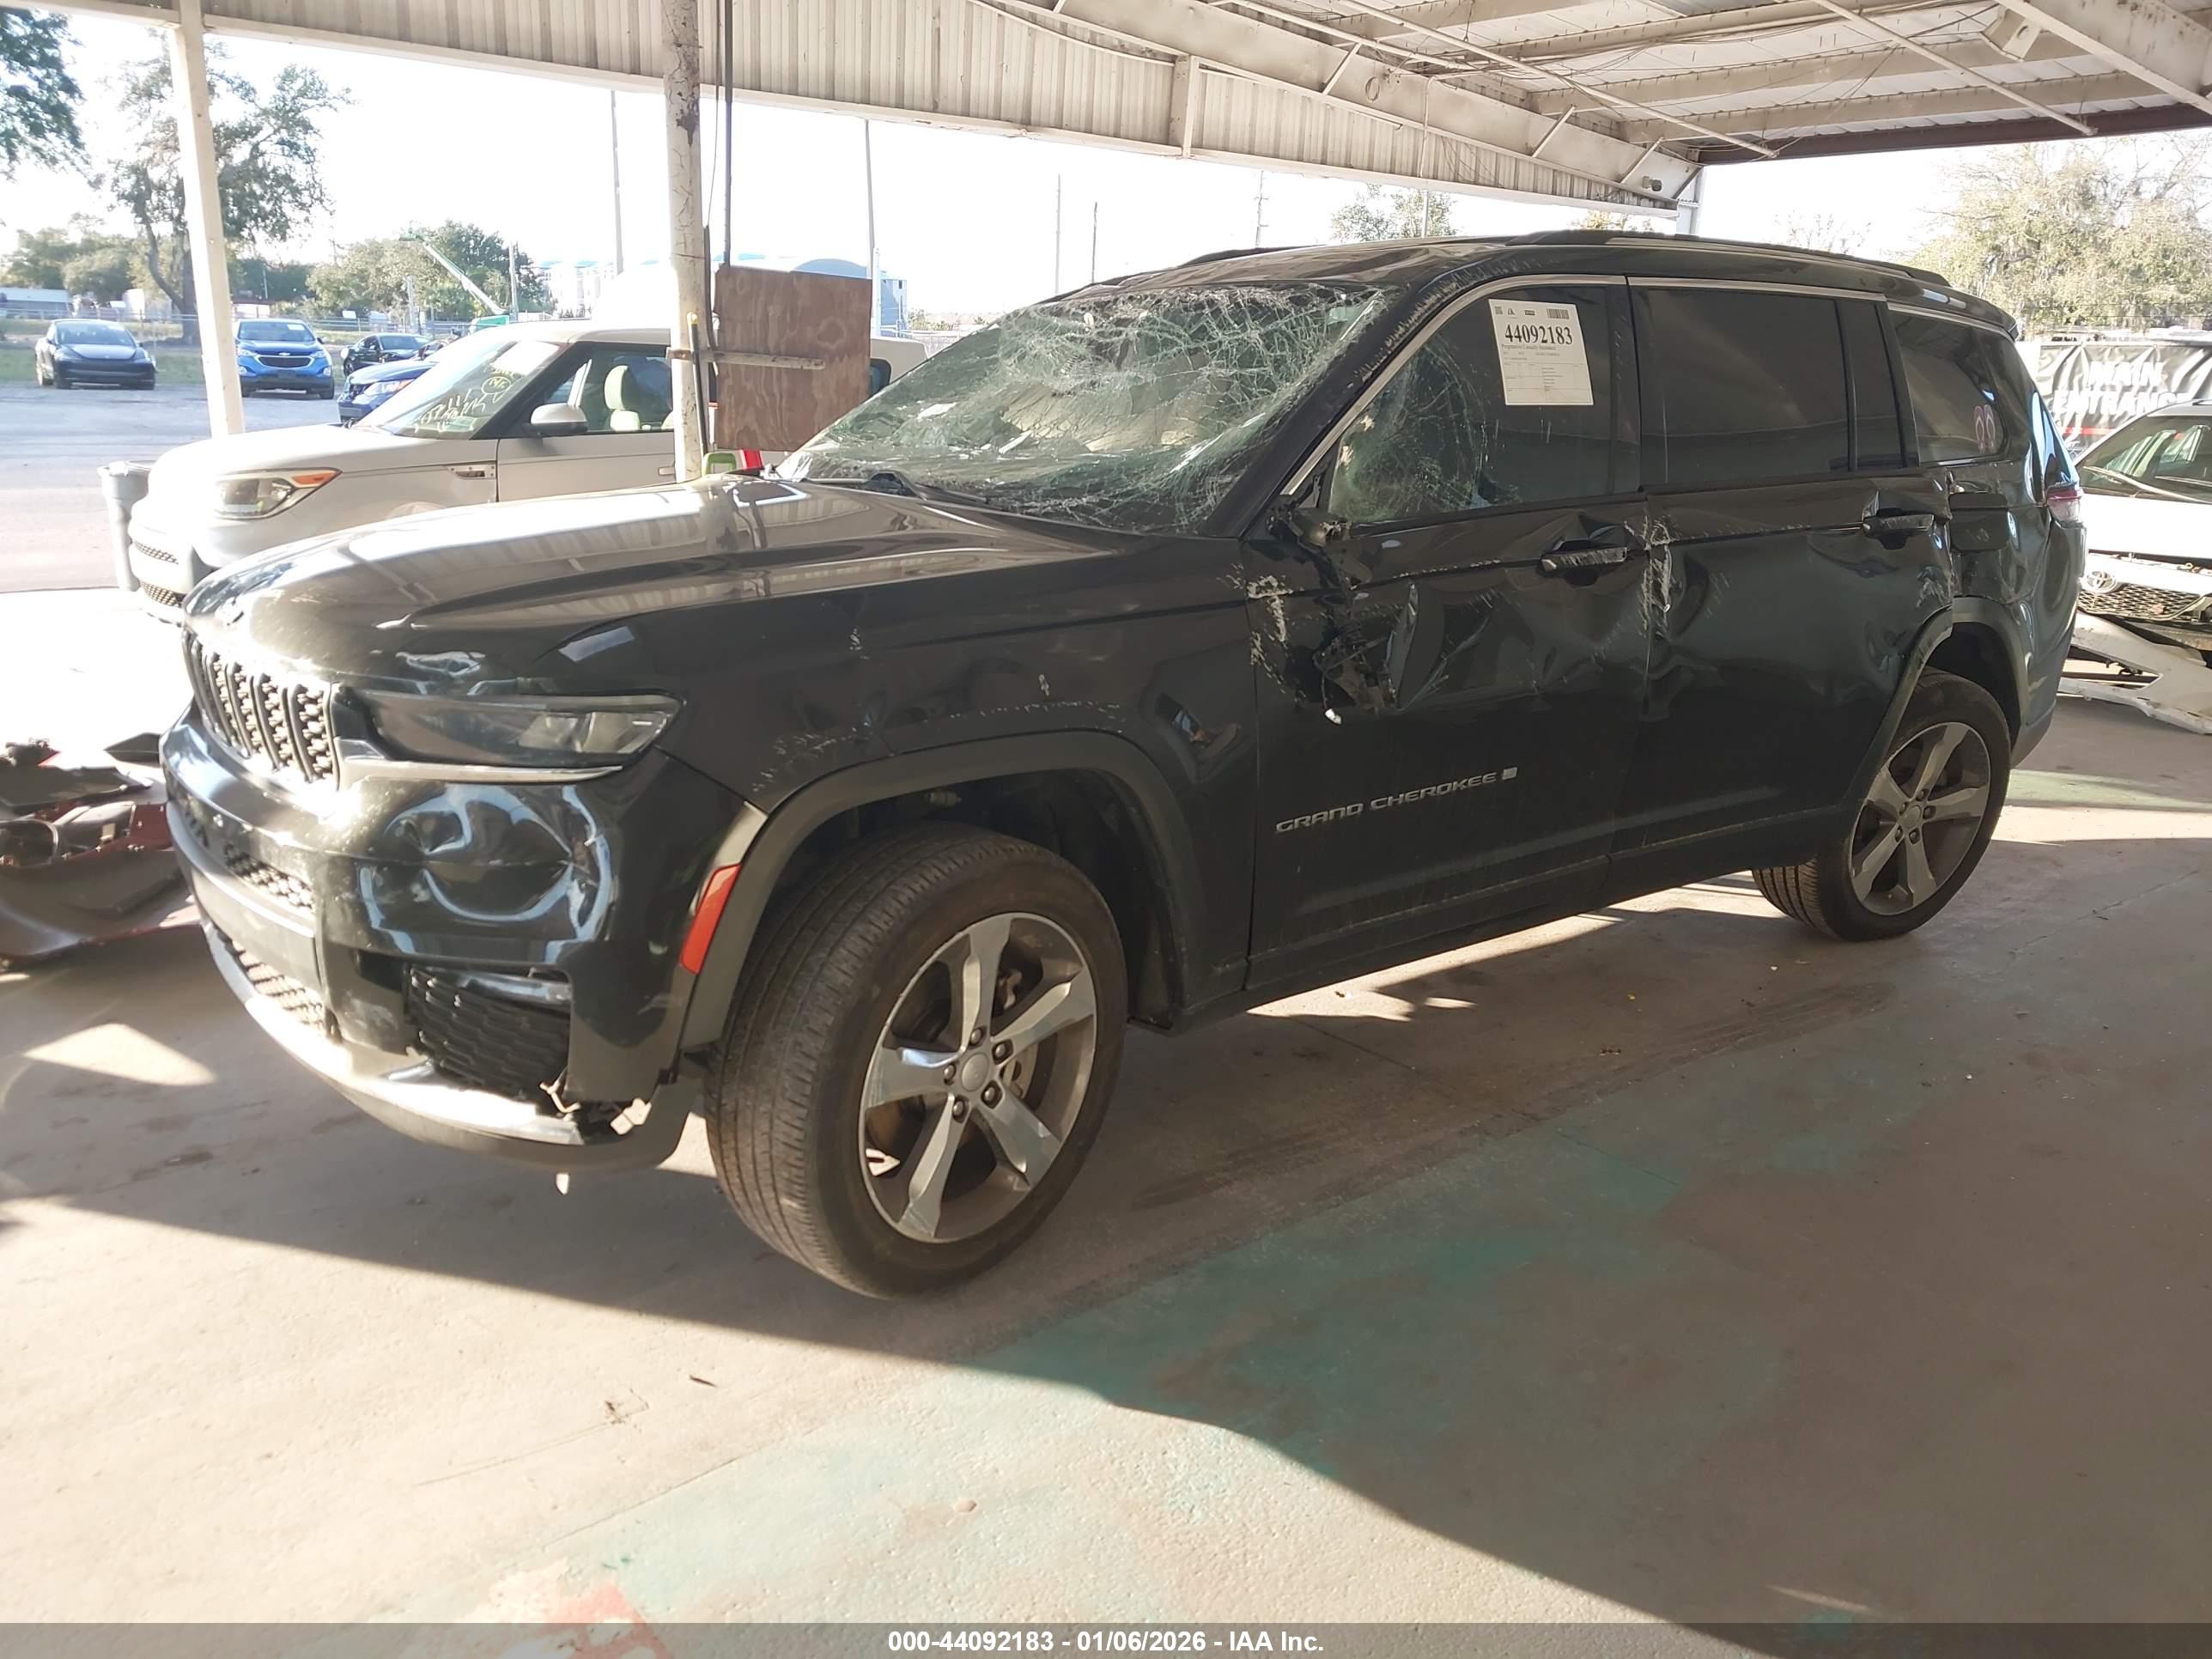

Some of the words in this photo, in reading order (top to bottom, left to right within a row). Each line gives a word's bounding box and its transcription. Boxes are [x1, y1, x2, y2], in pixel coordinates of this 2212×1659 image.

[1504, 323, 1573, 345] 44092183
[2087, 361, 2165, 386] MAIN
[1275, 803, 1364, 833] GRAND
[1370, 771, 1498, 810] CHEROKEE
